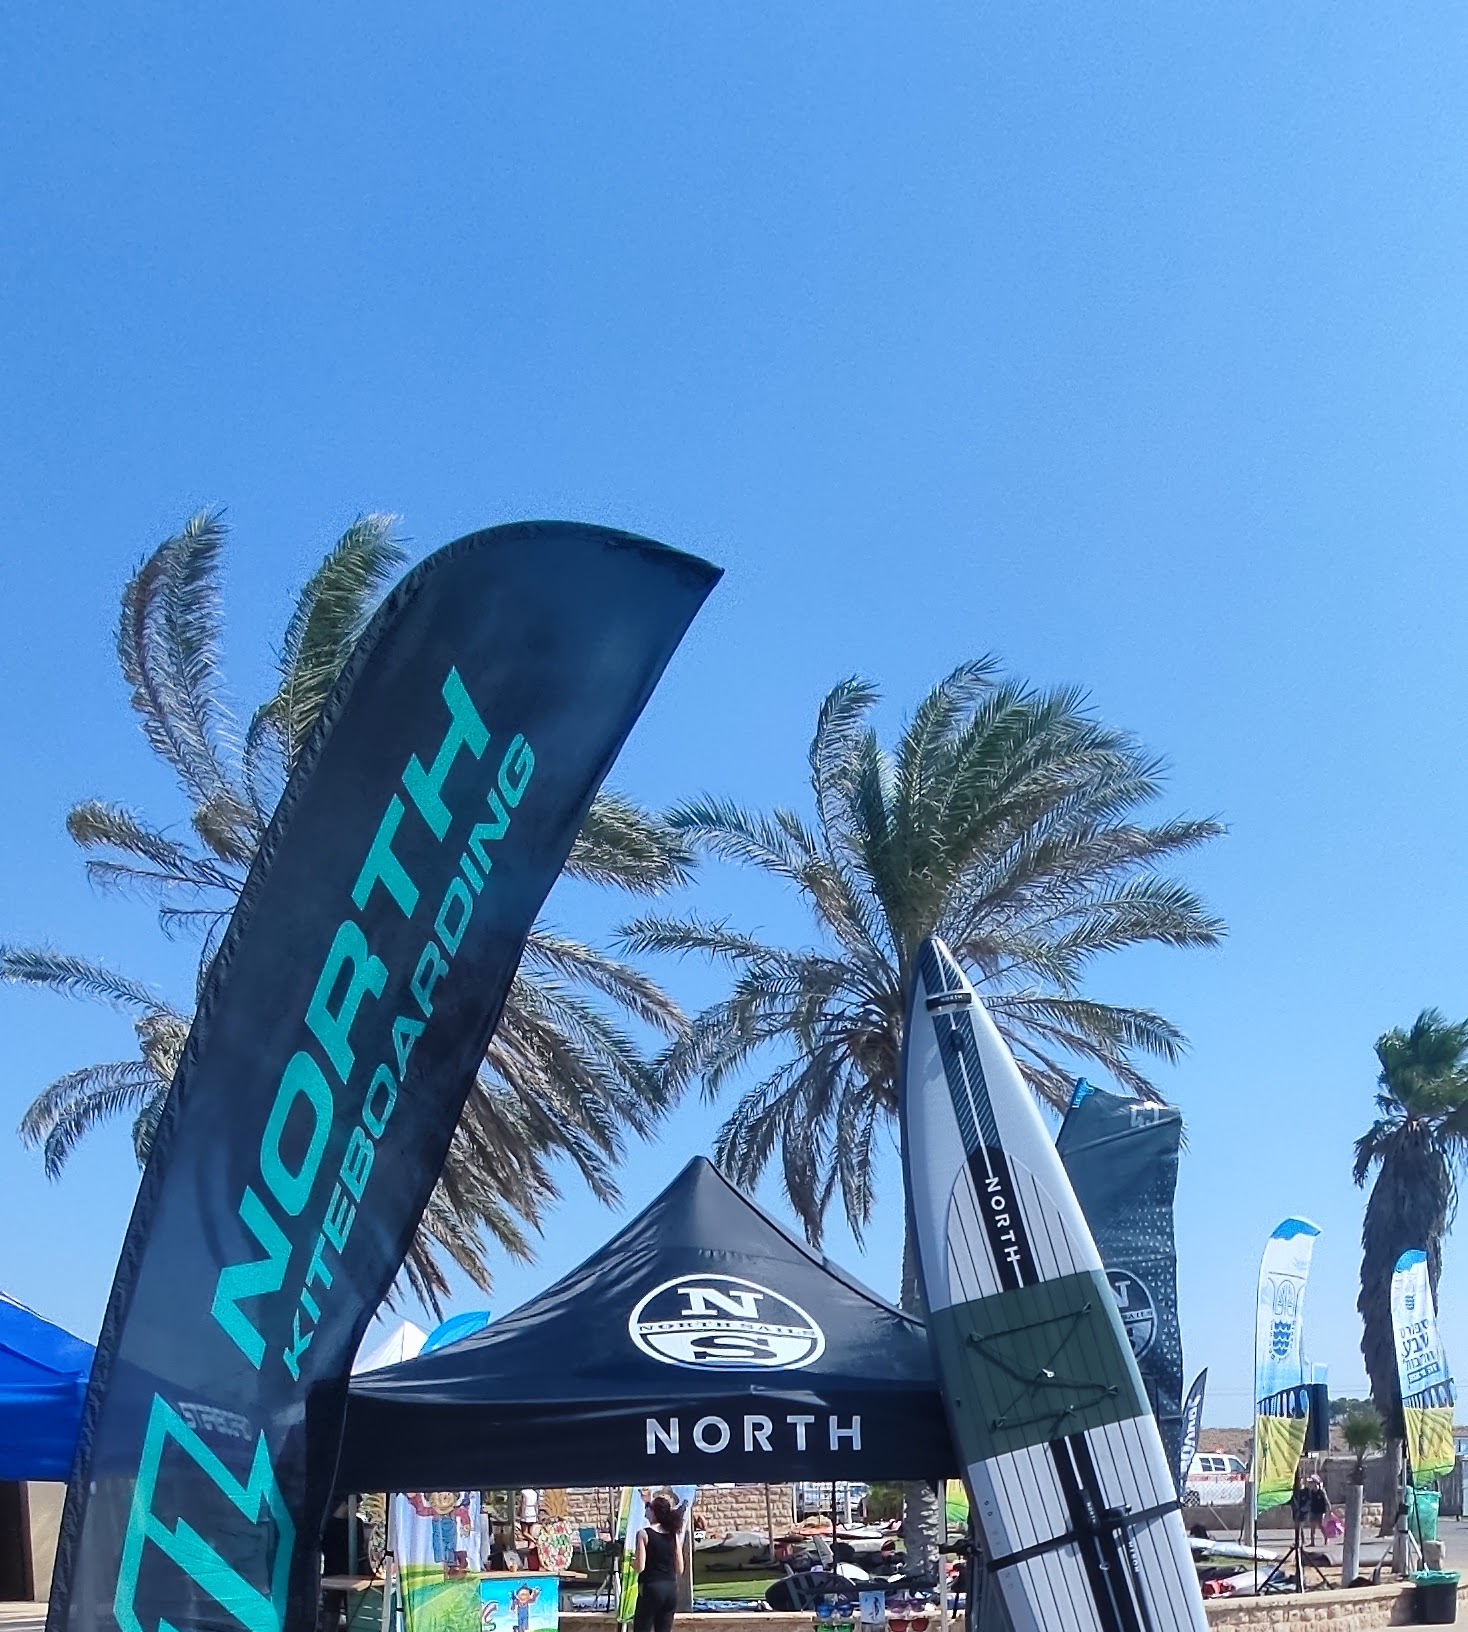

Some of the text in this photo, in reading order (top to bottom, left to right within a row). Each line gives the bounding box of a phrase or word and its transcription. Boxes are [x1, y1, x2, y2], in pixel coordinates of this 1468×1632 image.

[211, 666, 491, 1370] NORTH
[283, 732, 536, 1381] KITEBOARDING
[985, 1177, 1020, 1263] NORTH
[677, 1288, 764, 1319] N
[639, 1321, 731, 1332] NORTH
[690, 1335, 778, 1360] S
[646, 1414, 862, 1454] NORTH
